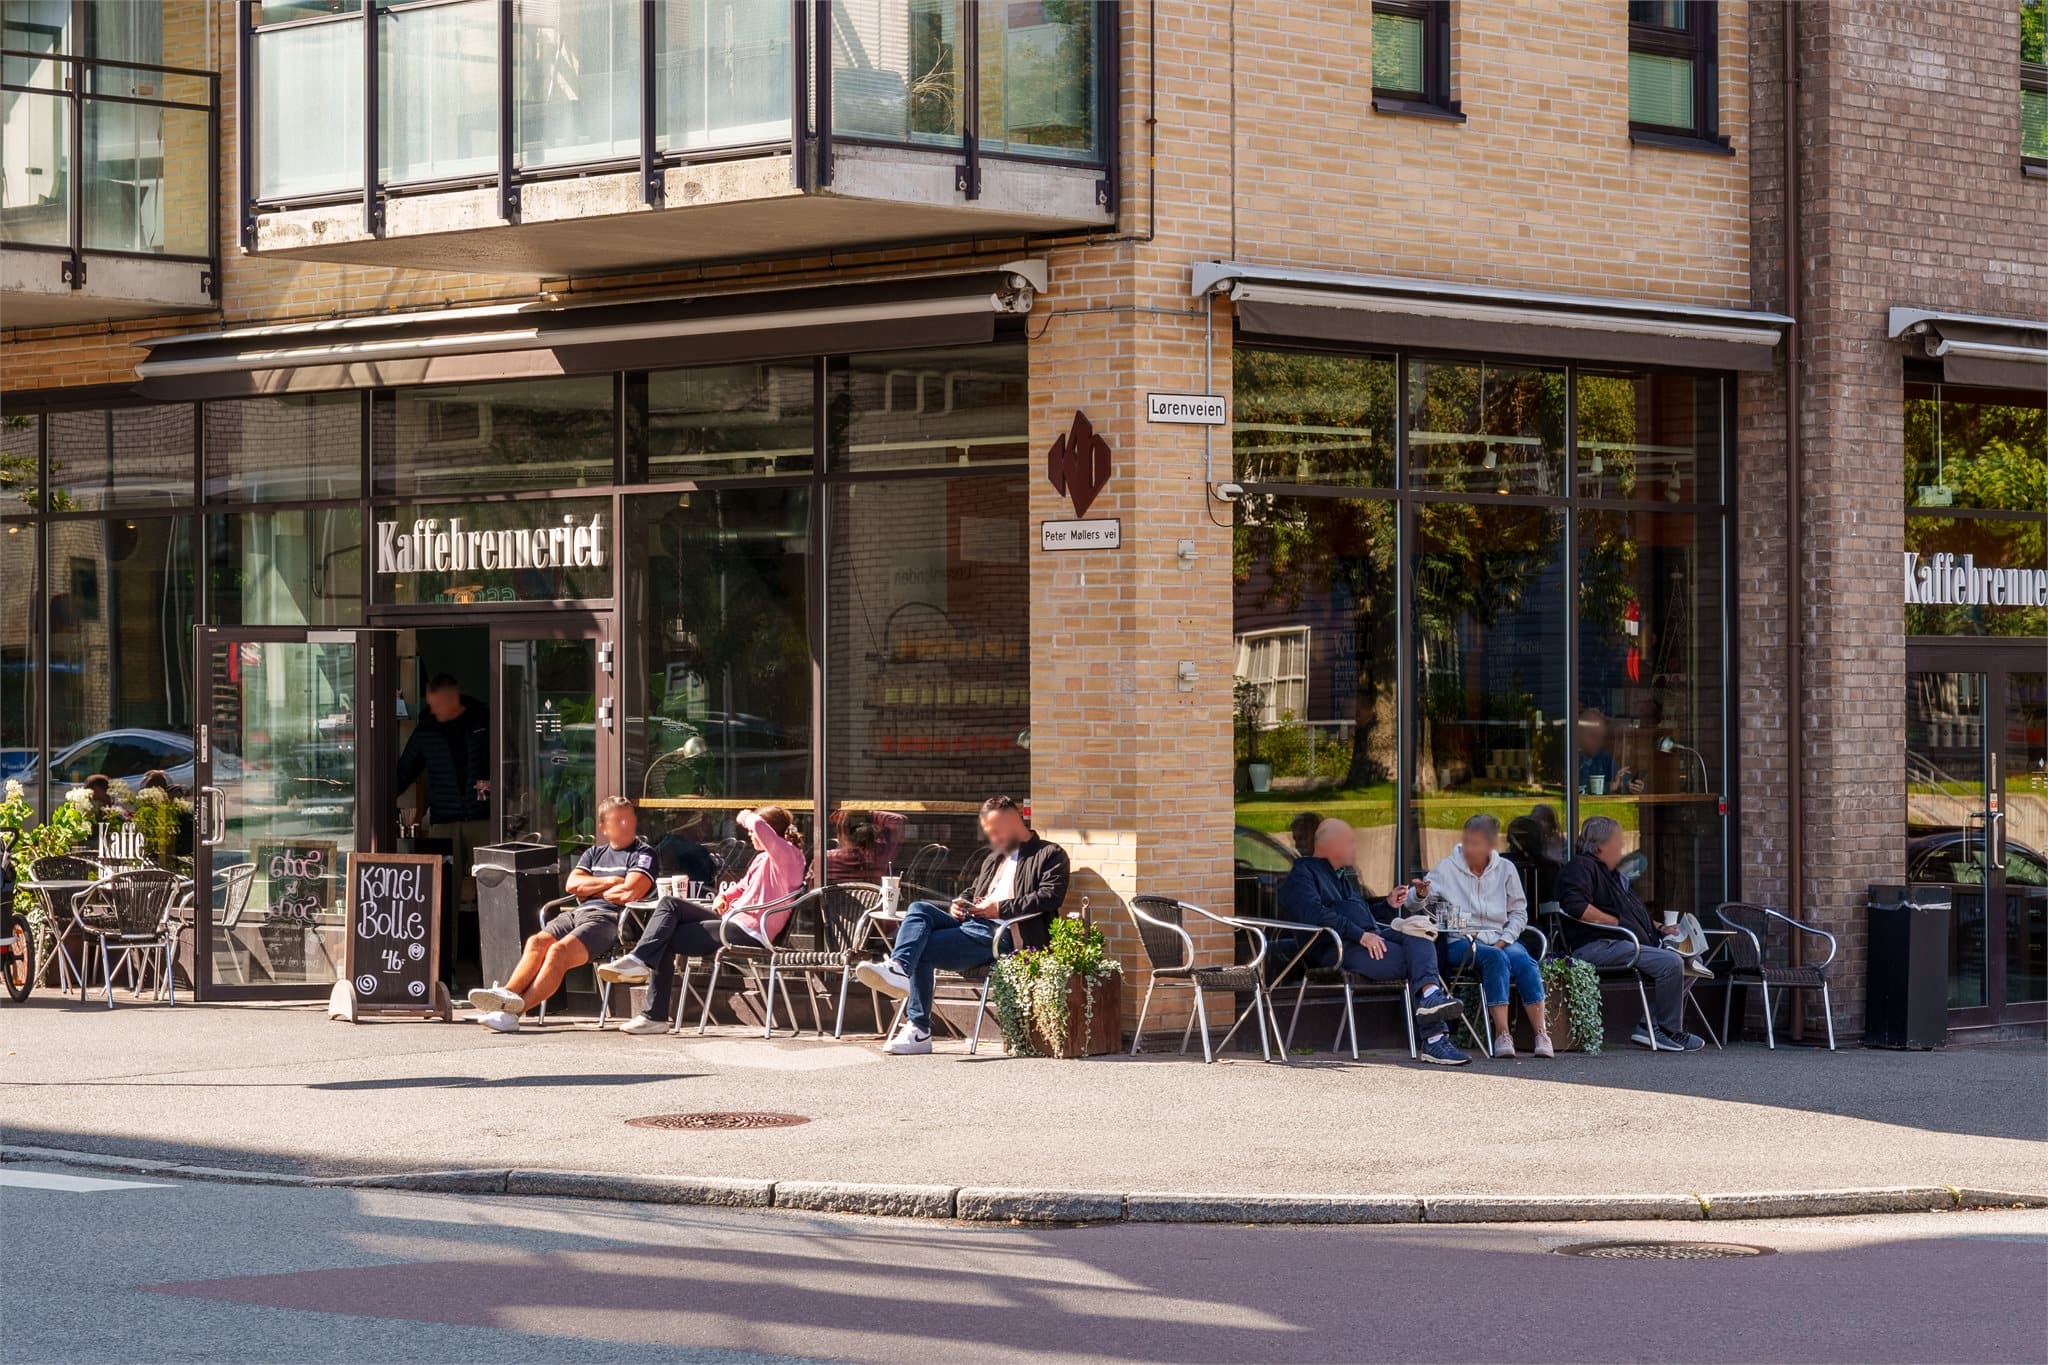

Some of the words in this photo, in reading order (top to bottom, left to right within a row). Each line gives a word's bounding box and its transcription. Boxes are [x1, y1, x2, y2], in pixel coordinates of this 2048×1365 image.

[1151, 399, 1223, 417] Lørenveien
[376, 513, 604, 574] Kaffebrenneriet
[1045, 530, 1066, 541] Peter
[1070, 529, 1100, 540] Møllers
[1104, 528, 1117, 539] vei
[1904, 552, 2048, 606] Kaffebrenne
[98, 822, 145, 860] Kaffe
[360, 865, 425, 904] Kanel
[358, 900, 425, 940] Bolle
